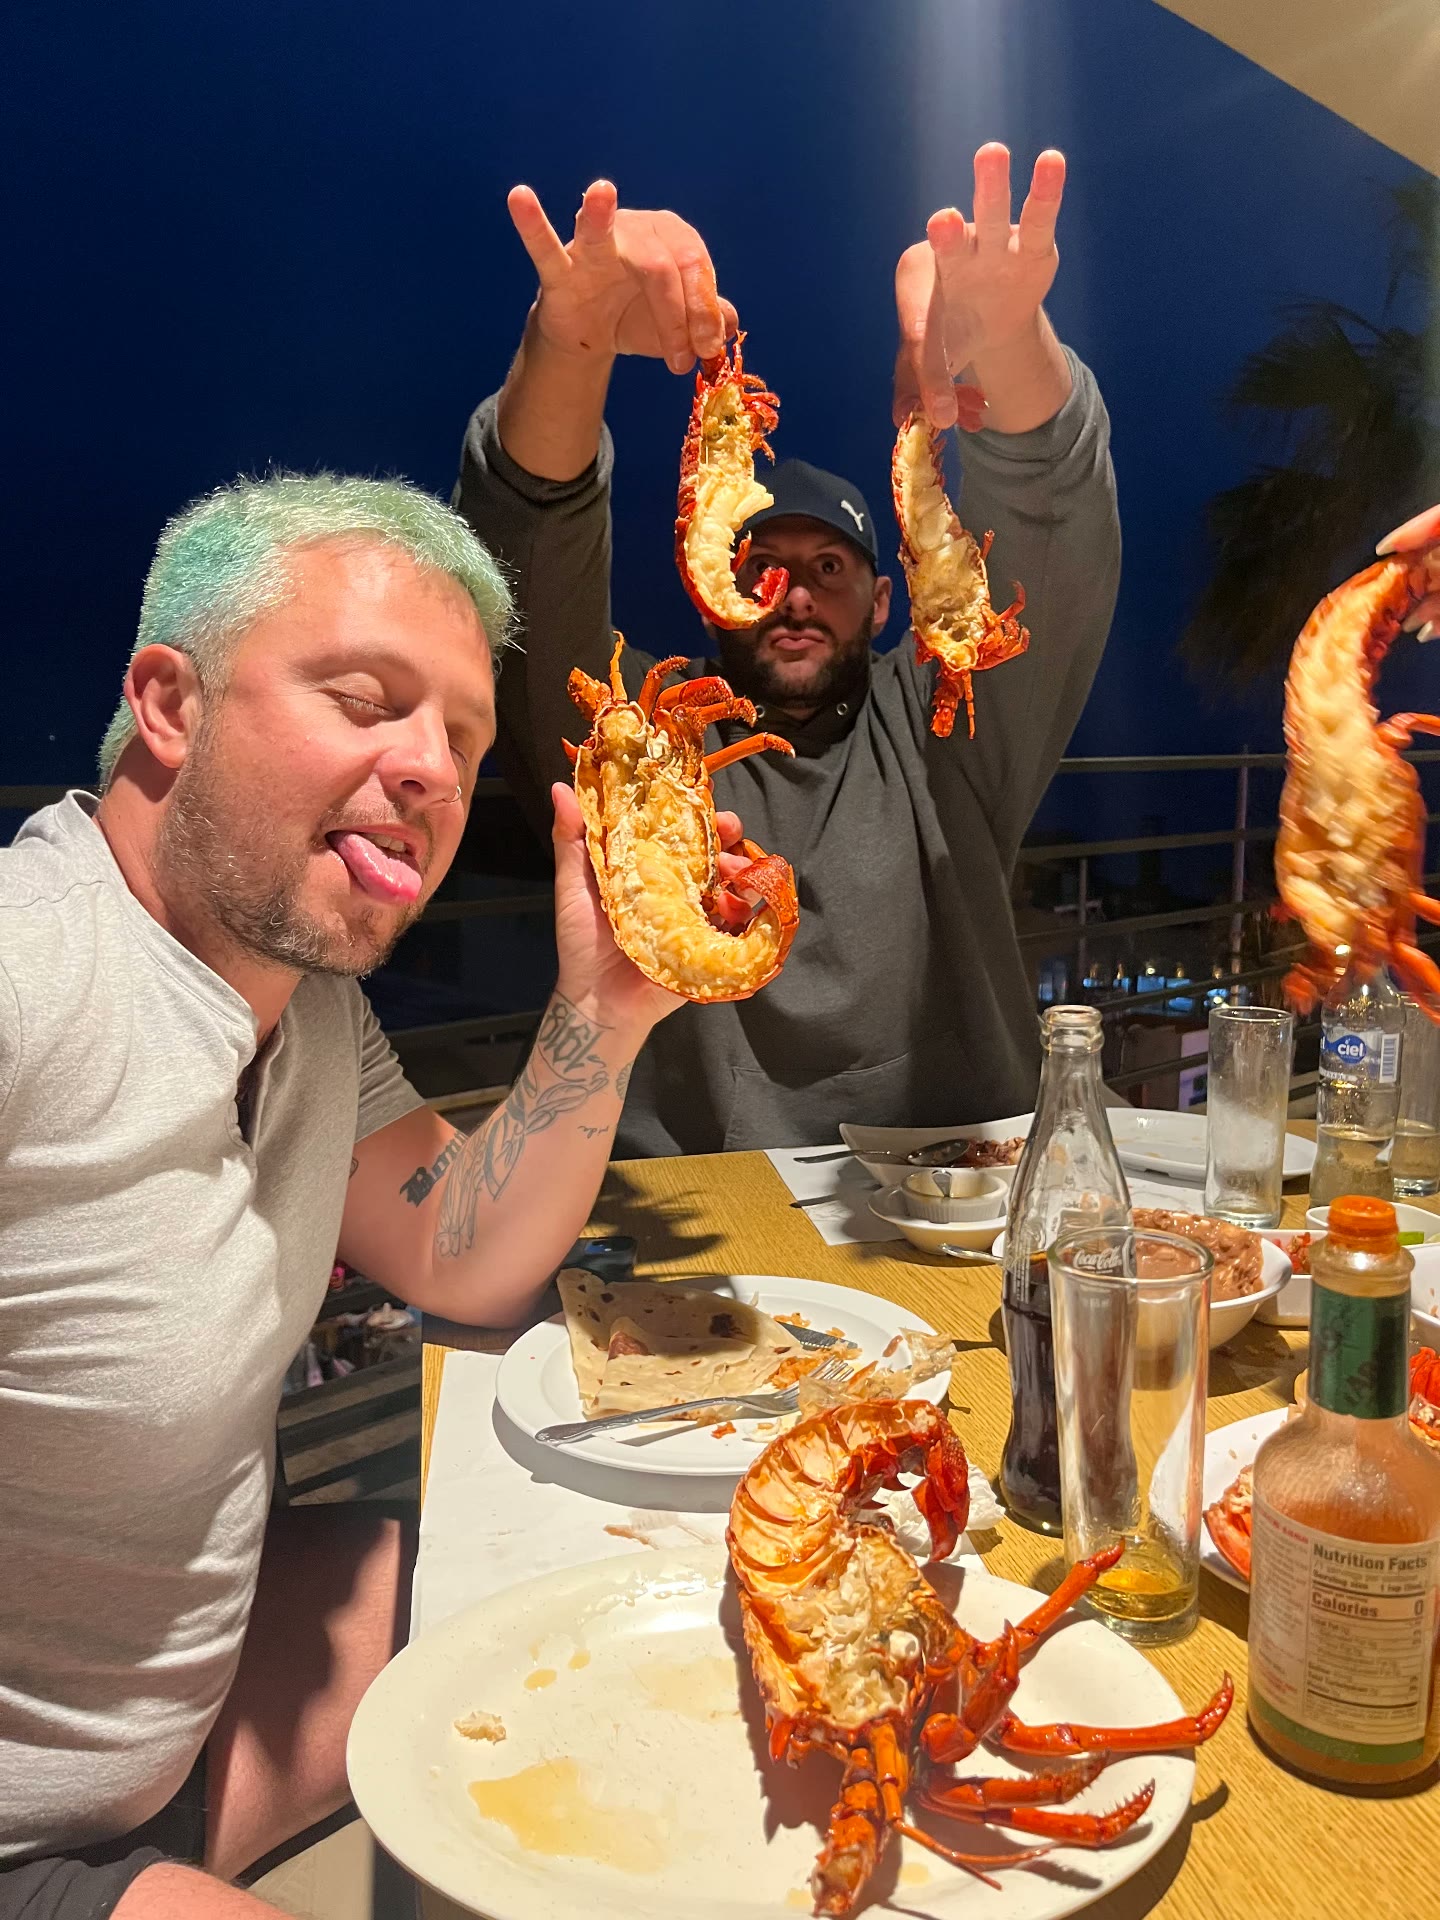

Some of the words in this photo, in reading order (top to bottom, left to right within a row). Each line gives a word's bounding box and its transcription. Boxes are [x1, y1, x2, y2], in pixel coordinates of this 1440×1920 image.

[1337, 1039, 1365, 1057] ciel
[1313, 1543, 1385, 1570] Nutrition
[1388, 1555, 1428, 1571] Facts
[1311, 1591, 1378, 1617] Calories
[1413, 1600, 1424, 1616] 0
